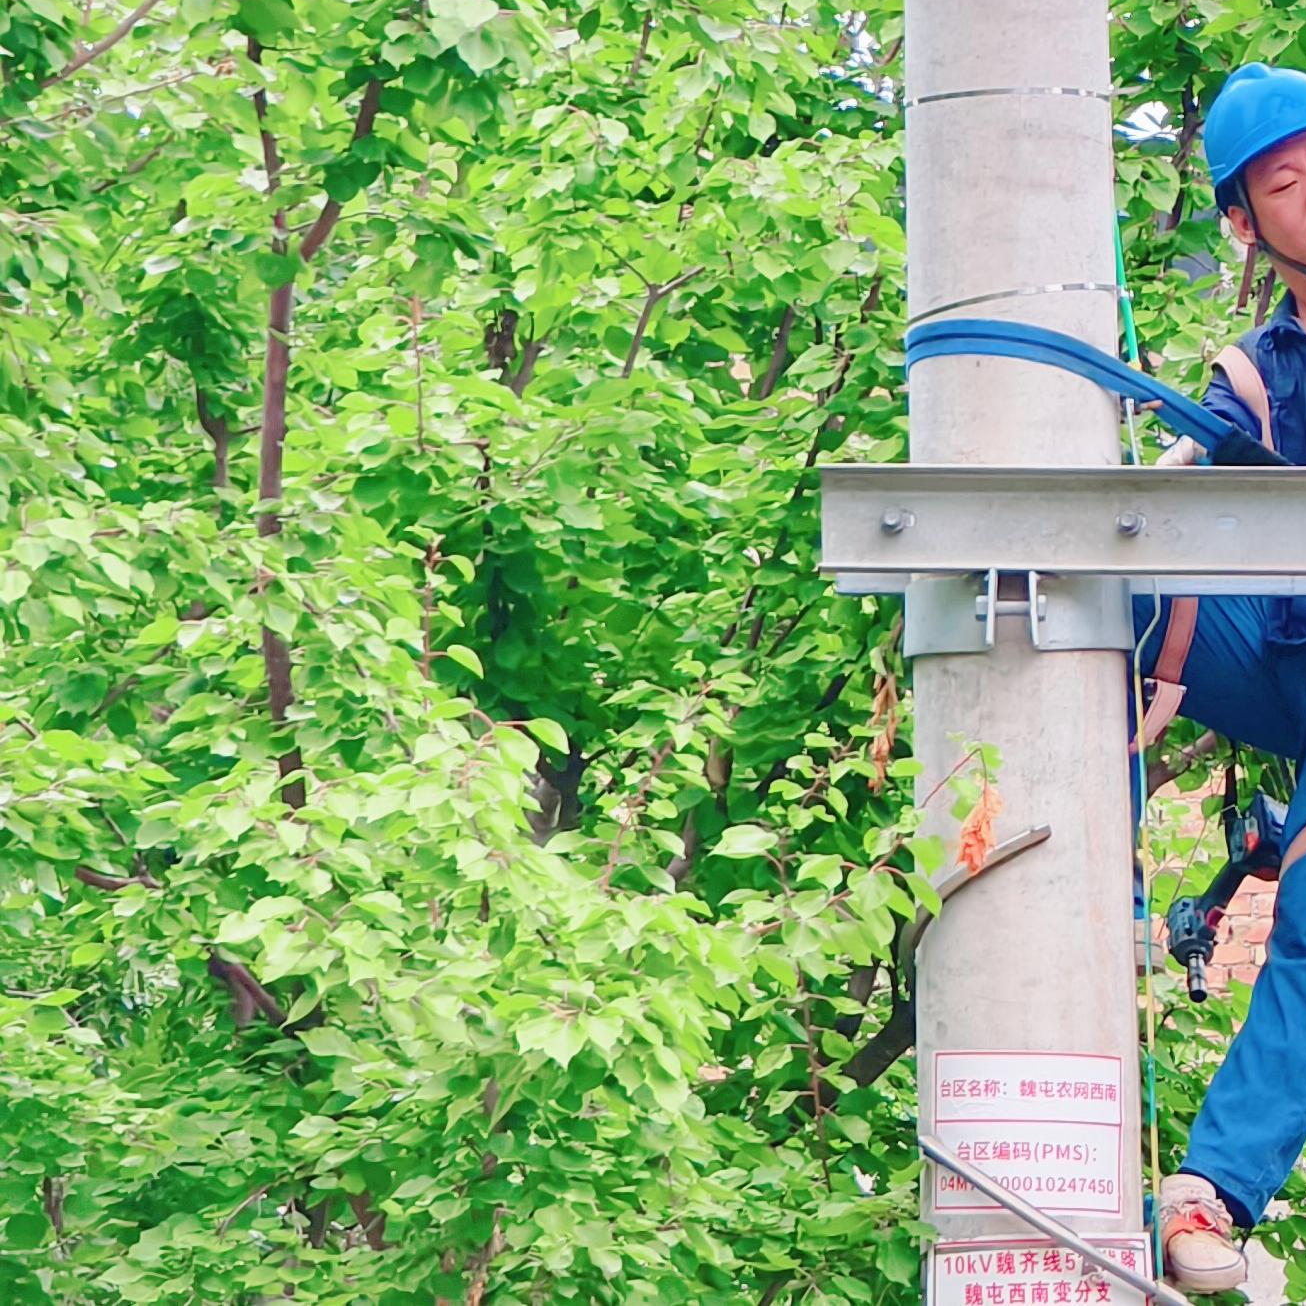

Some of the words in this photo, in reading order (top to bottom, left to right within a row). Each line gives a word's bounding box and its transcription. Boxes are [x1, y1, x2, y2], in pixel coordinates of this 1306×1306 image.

[1019, 1080, 1117, 1102] 魏屯农网西南
[965, 1281, 1111, 1306] 魏屯西南变分支
